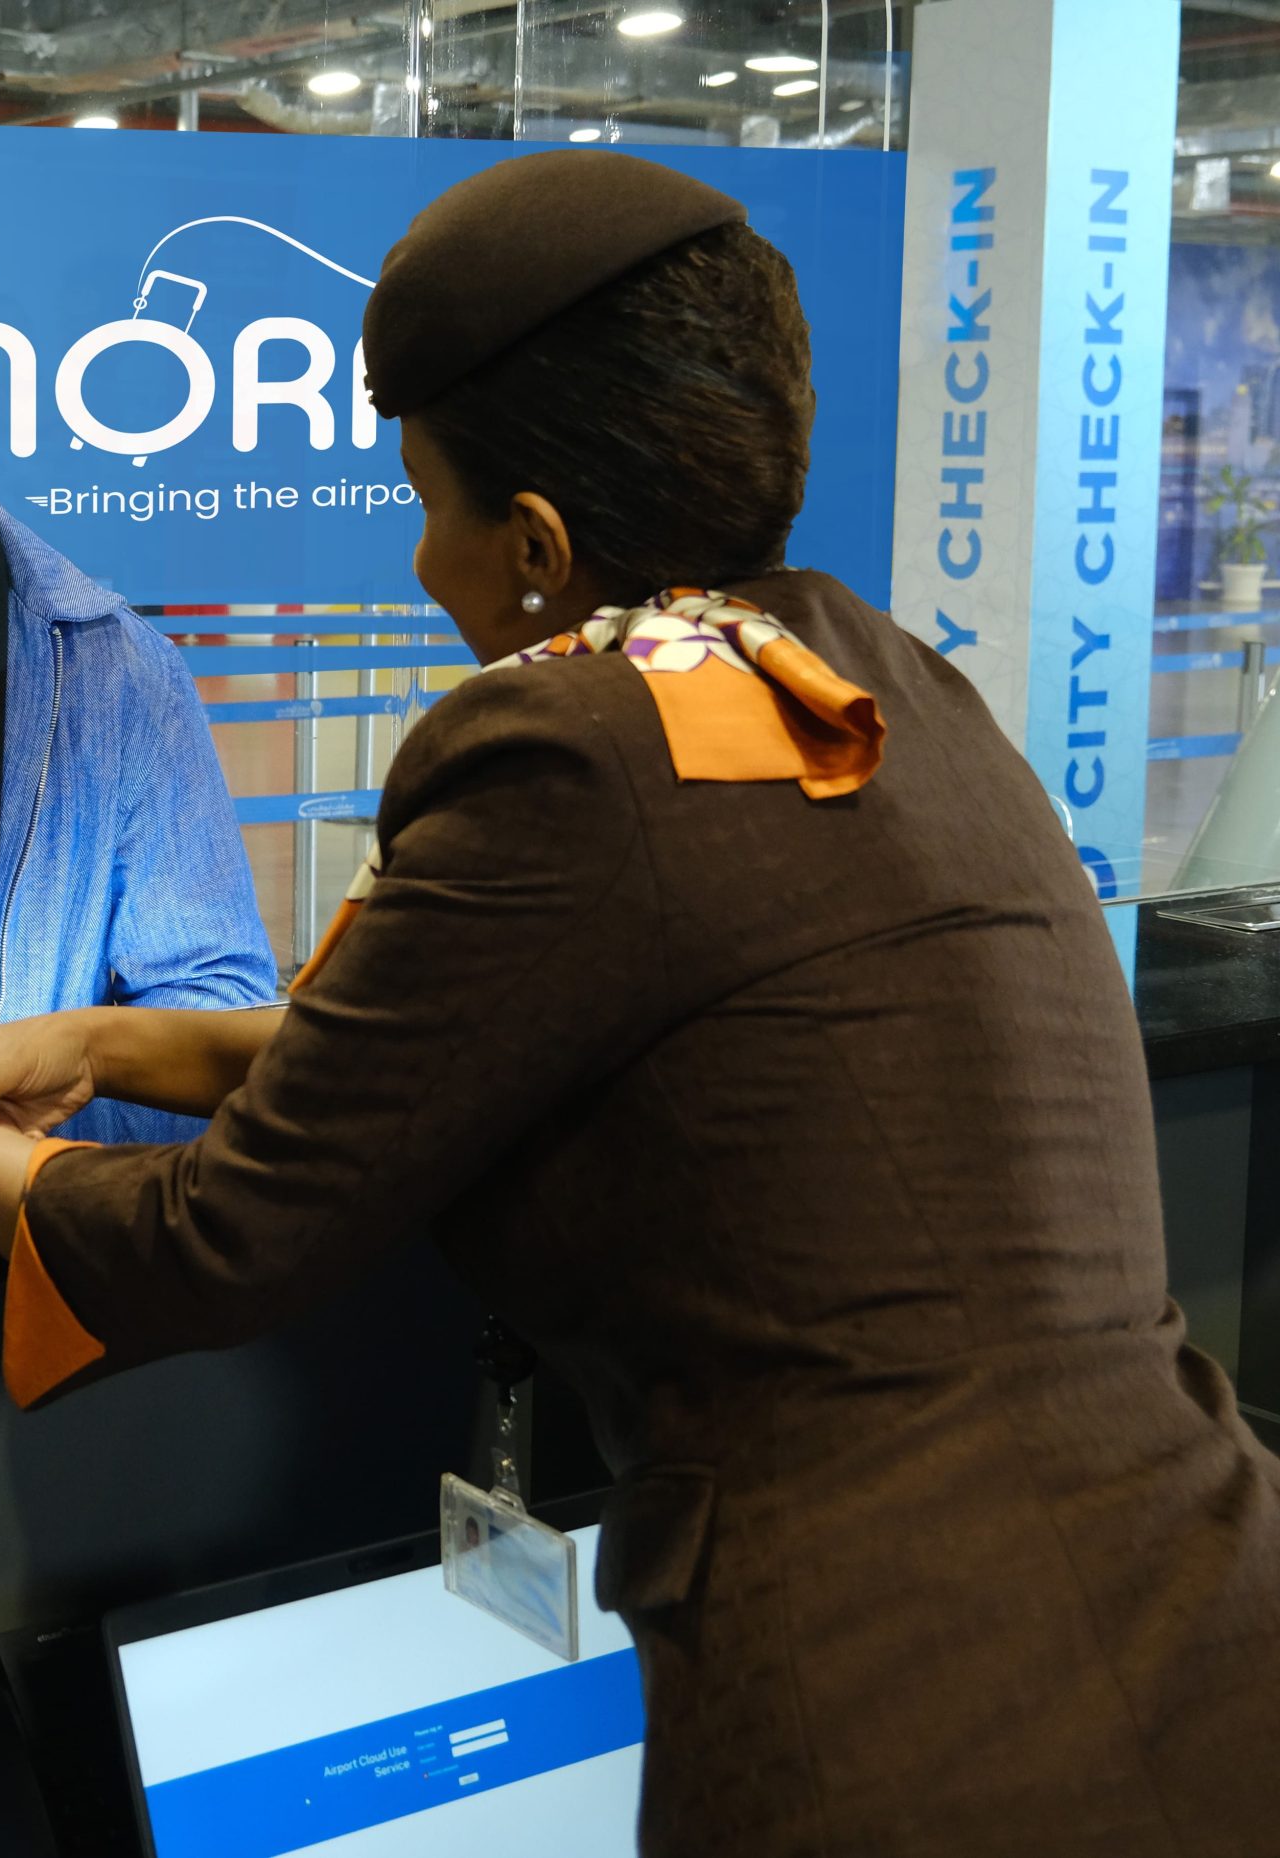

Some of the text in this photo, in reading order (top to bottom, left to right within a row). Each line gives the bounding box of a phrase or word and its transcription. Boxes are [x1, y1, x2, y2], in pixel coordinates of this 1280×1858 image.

[938, 166, 997, 580] CHECK-IN
[1075, 167, 1129, 585] CHECK-IN
[49, 478, 423, 521] Bringing the airpo
[1064, 615, 1111, 809] CITY
[323, 1745, 408, 1778] Airport Cloud Use
[374, 1760, 411, 1779] Service
